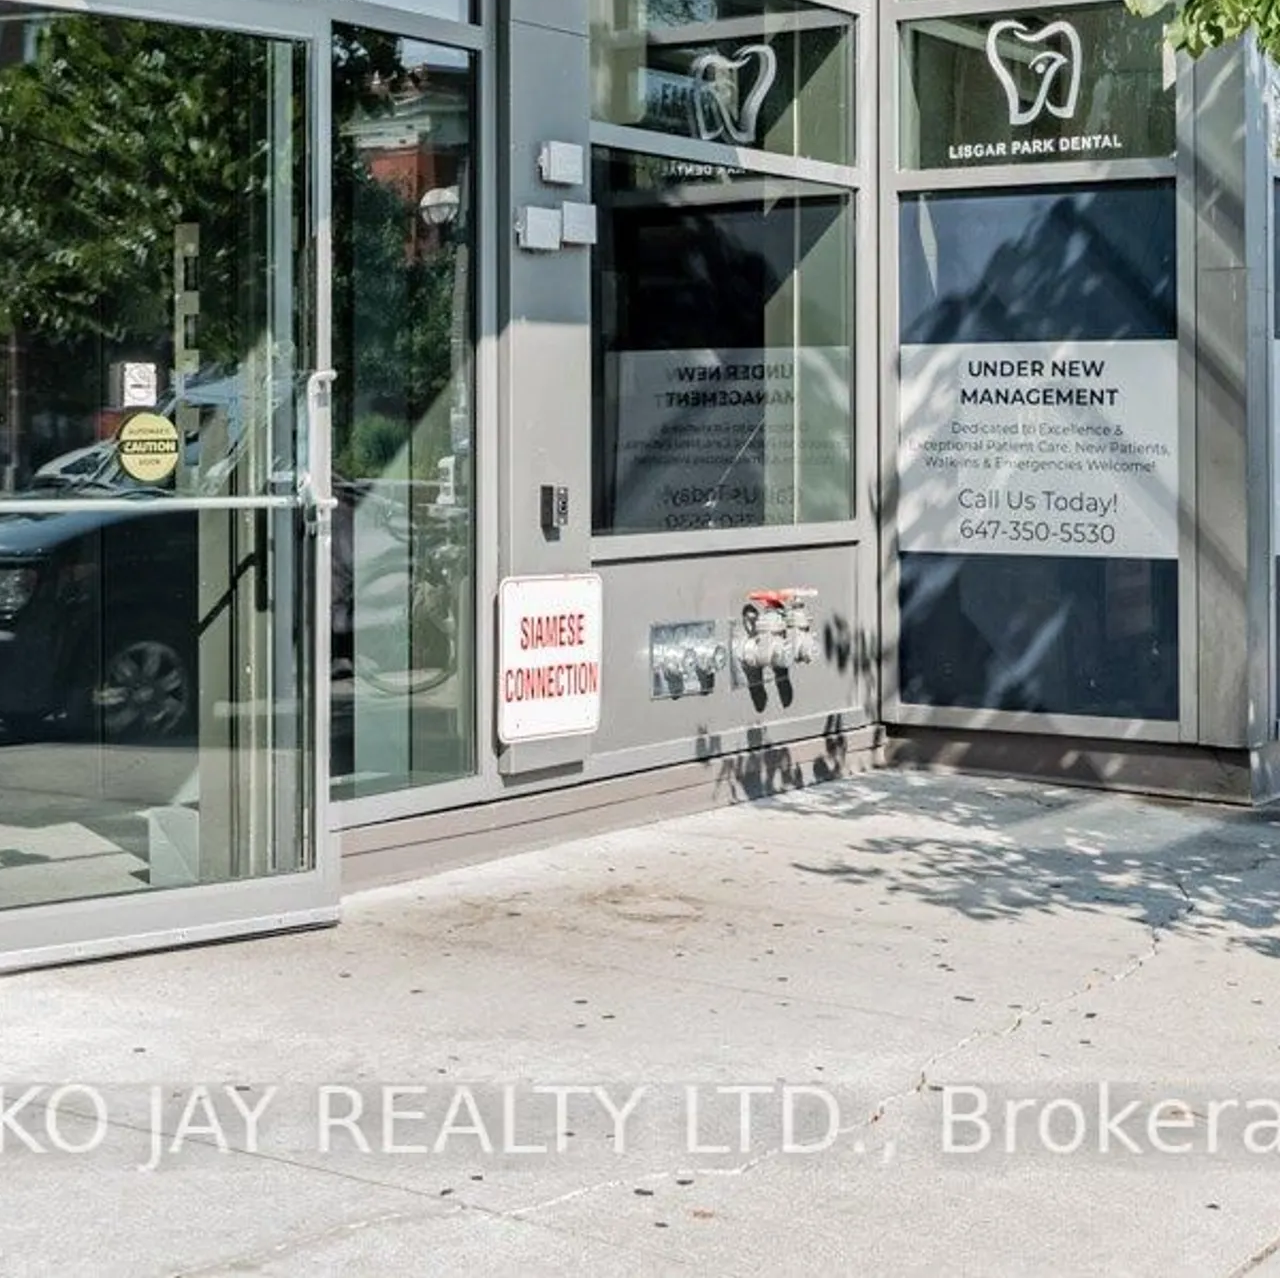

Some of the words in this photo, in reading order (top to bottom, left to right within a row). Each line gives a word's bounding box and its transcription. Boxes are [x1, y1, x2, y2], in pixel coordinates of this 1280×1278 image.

[948, 143, 1006, 159] LISGAR
[1011, 138, 1055, 155] PARK
[1059, 134, 1122, 151] DENTAL
[968, 360, 1044, 377] UNDER
[1051, 360, 1105, 377] NEW
[960, 388, 1119, 406] MANAGEMENT
[951, 421, 1018, 435] Dedicated
[1022, 422, 1036, 436] to
[1039, 422, 1111, 436] Excellence
[1114, 423, 1123, 436] &
[124, 440, 176, 454] CAUTION
[986, 440, 1034, 454] Patient
[1075, 441, 1106, 455] New
[983, 456, 992, 469] &
[958, 488, 999, 509] Call
[1007, 491, 1036, 510] Us
[1042, 490, 1118, 517] Today!
[960, 519, 1116, 544] 647-350-5530
[520, 613, 584, 649] SIAMESE
[505, 663, 597, 703] CONNECTION
